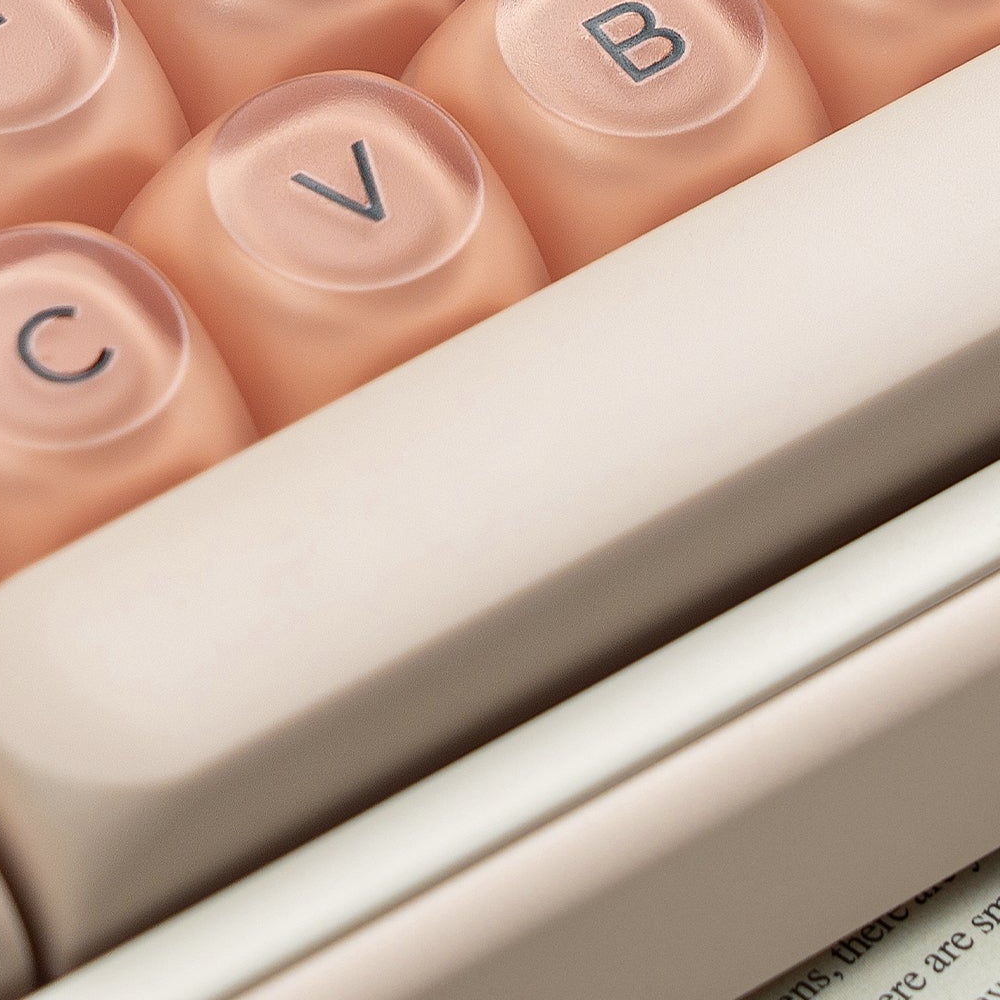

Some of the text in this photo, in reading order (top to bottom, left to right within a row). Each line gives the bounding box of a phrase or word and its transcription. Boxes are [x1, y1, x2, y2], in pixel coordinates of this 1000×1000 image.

[581, 1, 686, 83] B
[291, 140, 384, 223] V
[16, 306, 113, 384] C
[924, 931, 974, 973] are
